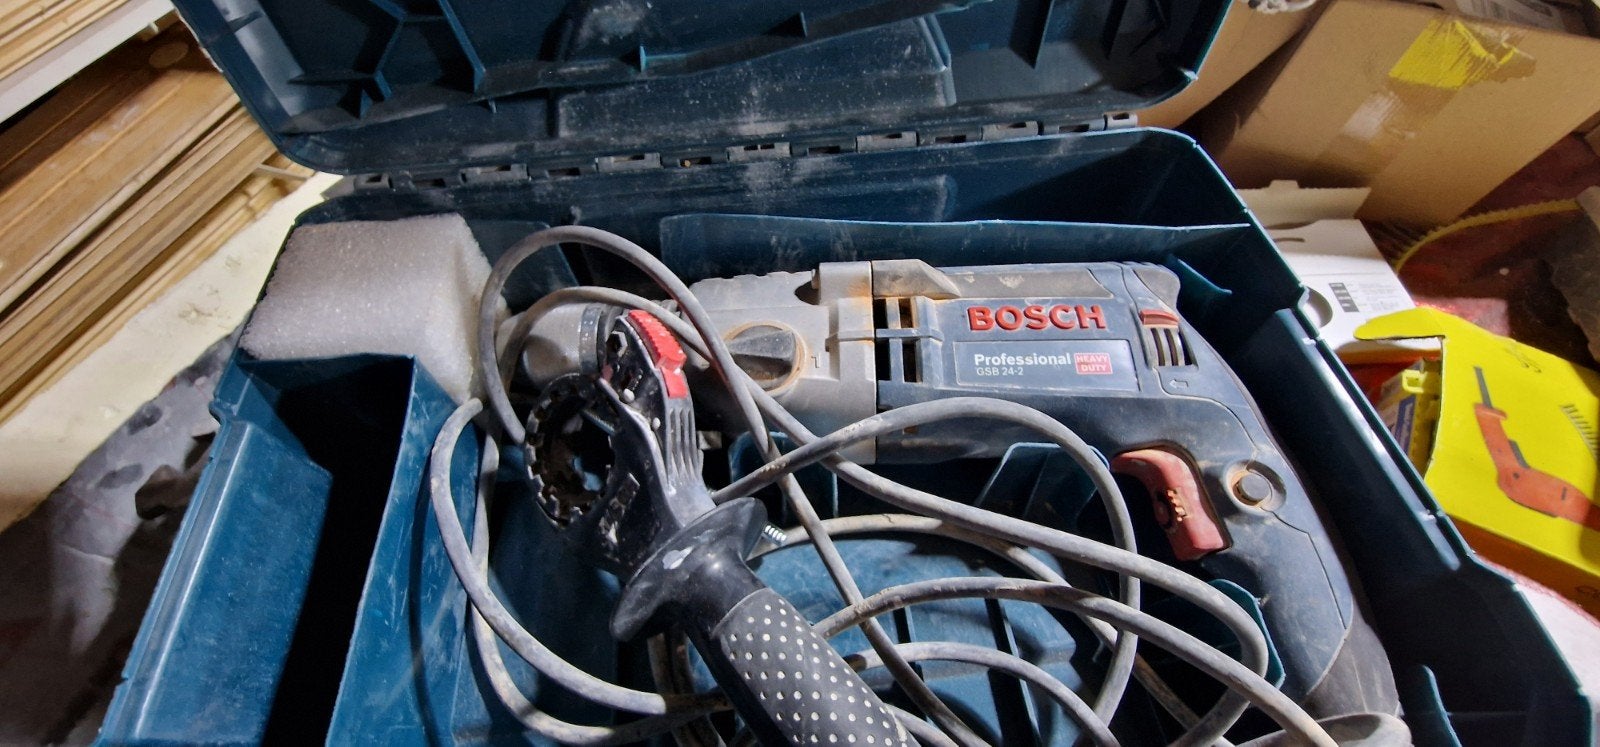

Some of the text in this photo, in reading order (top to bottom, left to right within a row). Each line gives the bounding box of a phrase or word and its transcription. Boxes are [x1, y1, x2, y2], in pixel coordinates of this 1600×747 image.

[967, 304, 1107, 332] BOSCH
[974, 353, 1072, 366] Professional
[1076, 355, 1108, 363] HEAVY
[976, 366, 1024, 376] GSB 24-2
[1080, 364, 1107, 372] DUTY
